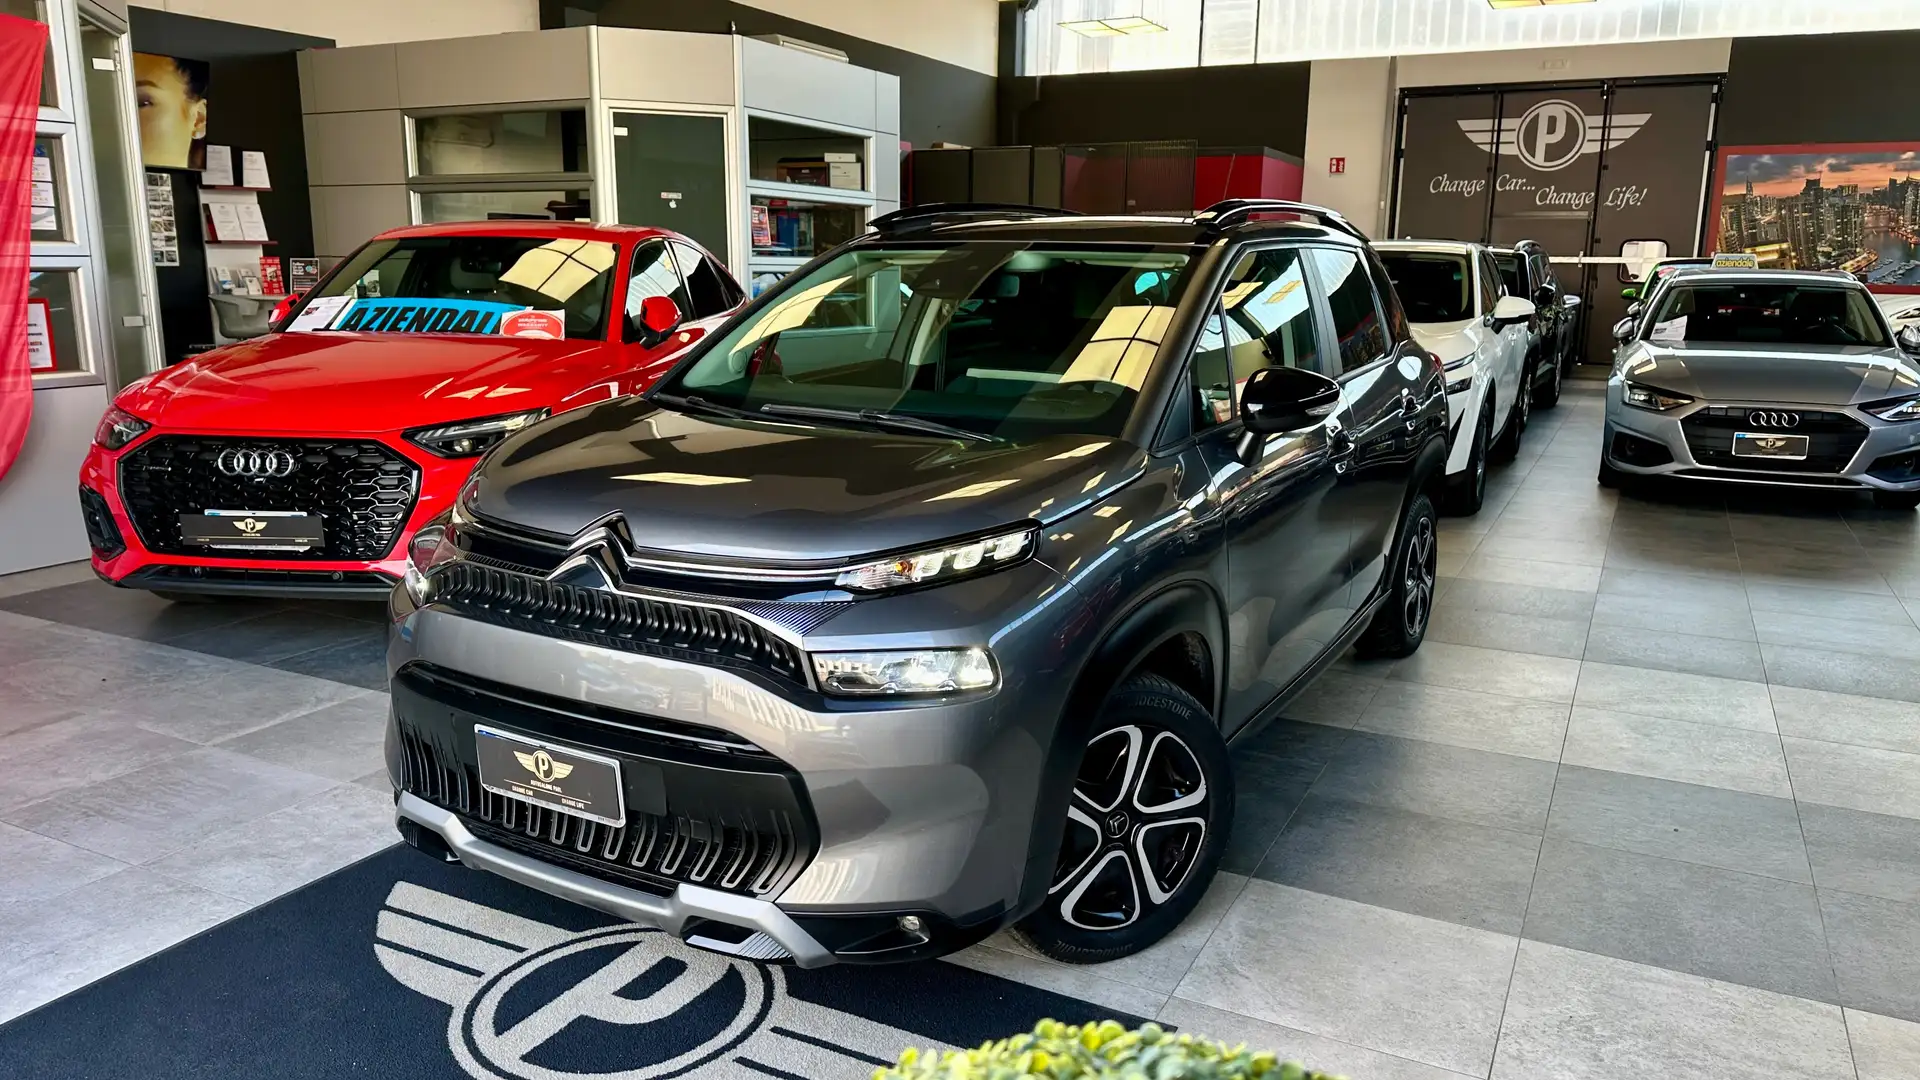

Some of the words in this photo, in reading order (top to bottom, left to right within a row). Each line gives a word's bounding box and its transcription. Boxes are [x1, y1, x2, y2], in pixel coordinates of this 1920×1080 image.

[1429, 174, 1485, 197] Change
[1496, 173, 1536, 192] Car...
[1535, 185, 1595, 210] Change
[1603, 186, 1648, 210] Life!
[1128, 695, 1193, 721] IDGESTONE
